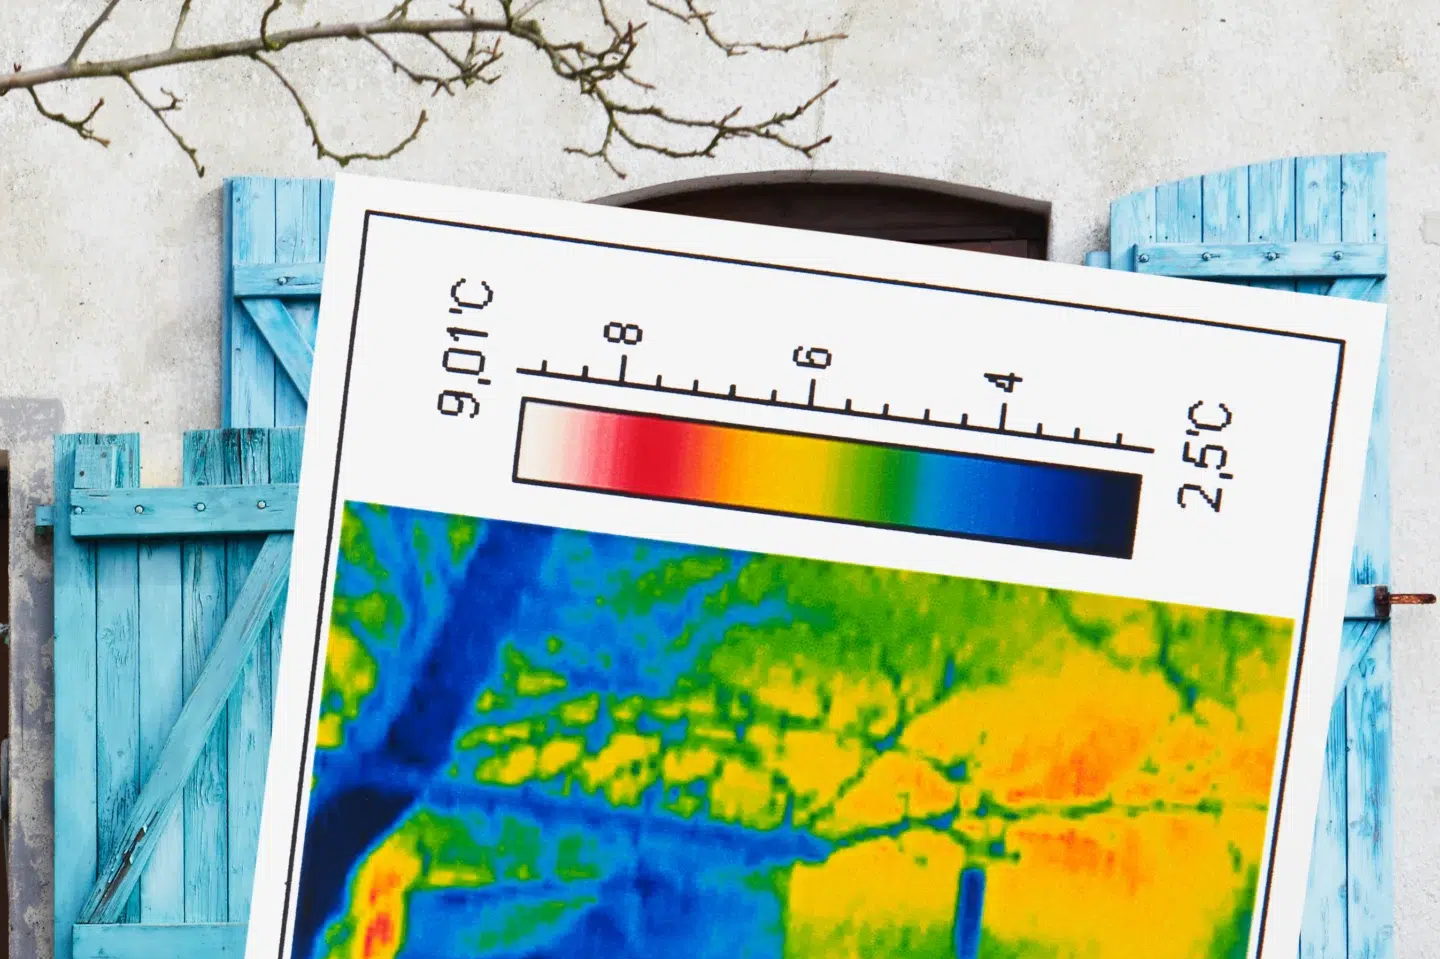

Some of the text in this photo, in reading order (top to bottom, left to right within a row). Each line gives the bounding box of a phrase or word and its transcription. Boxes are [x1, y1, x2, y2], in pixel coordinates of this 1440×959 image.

[603, 321, 644, 346] 8
[792, 345, 832, 370] 6
[983, 372, 1024, 393] 4
